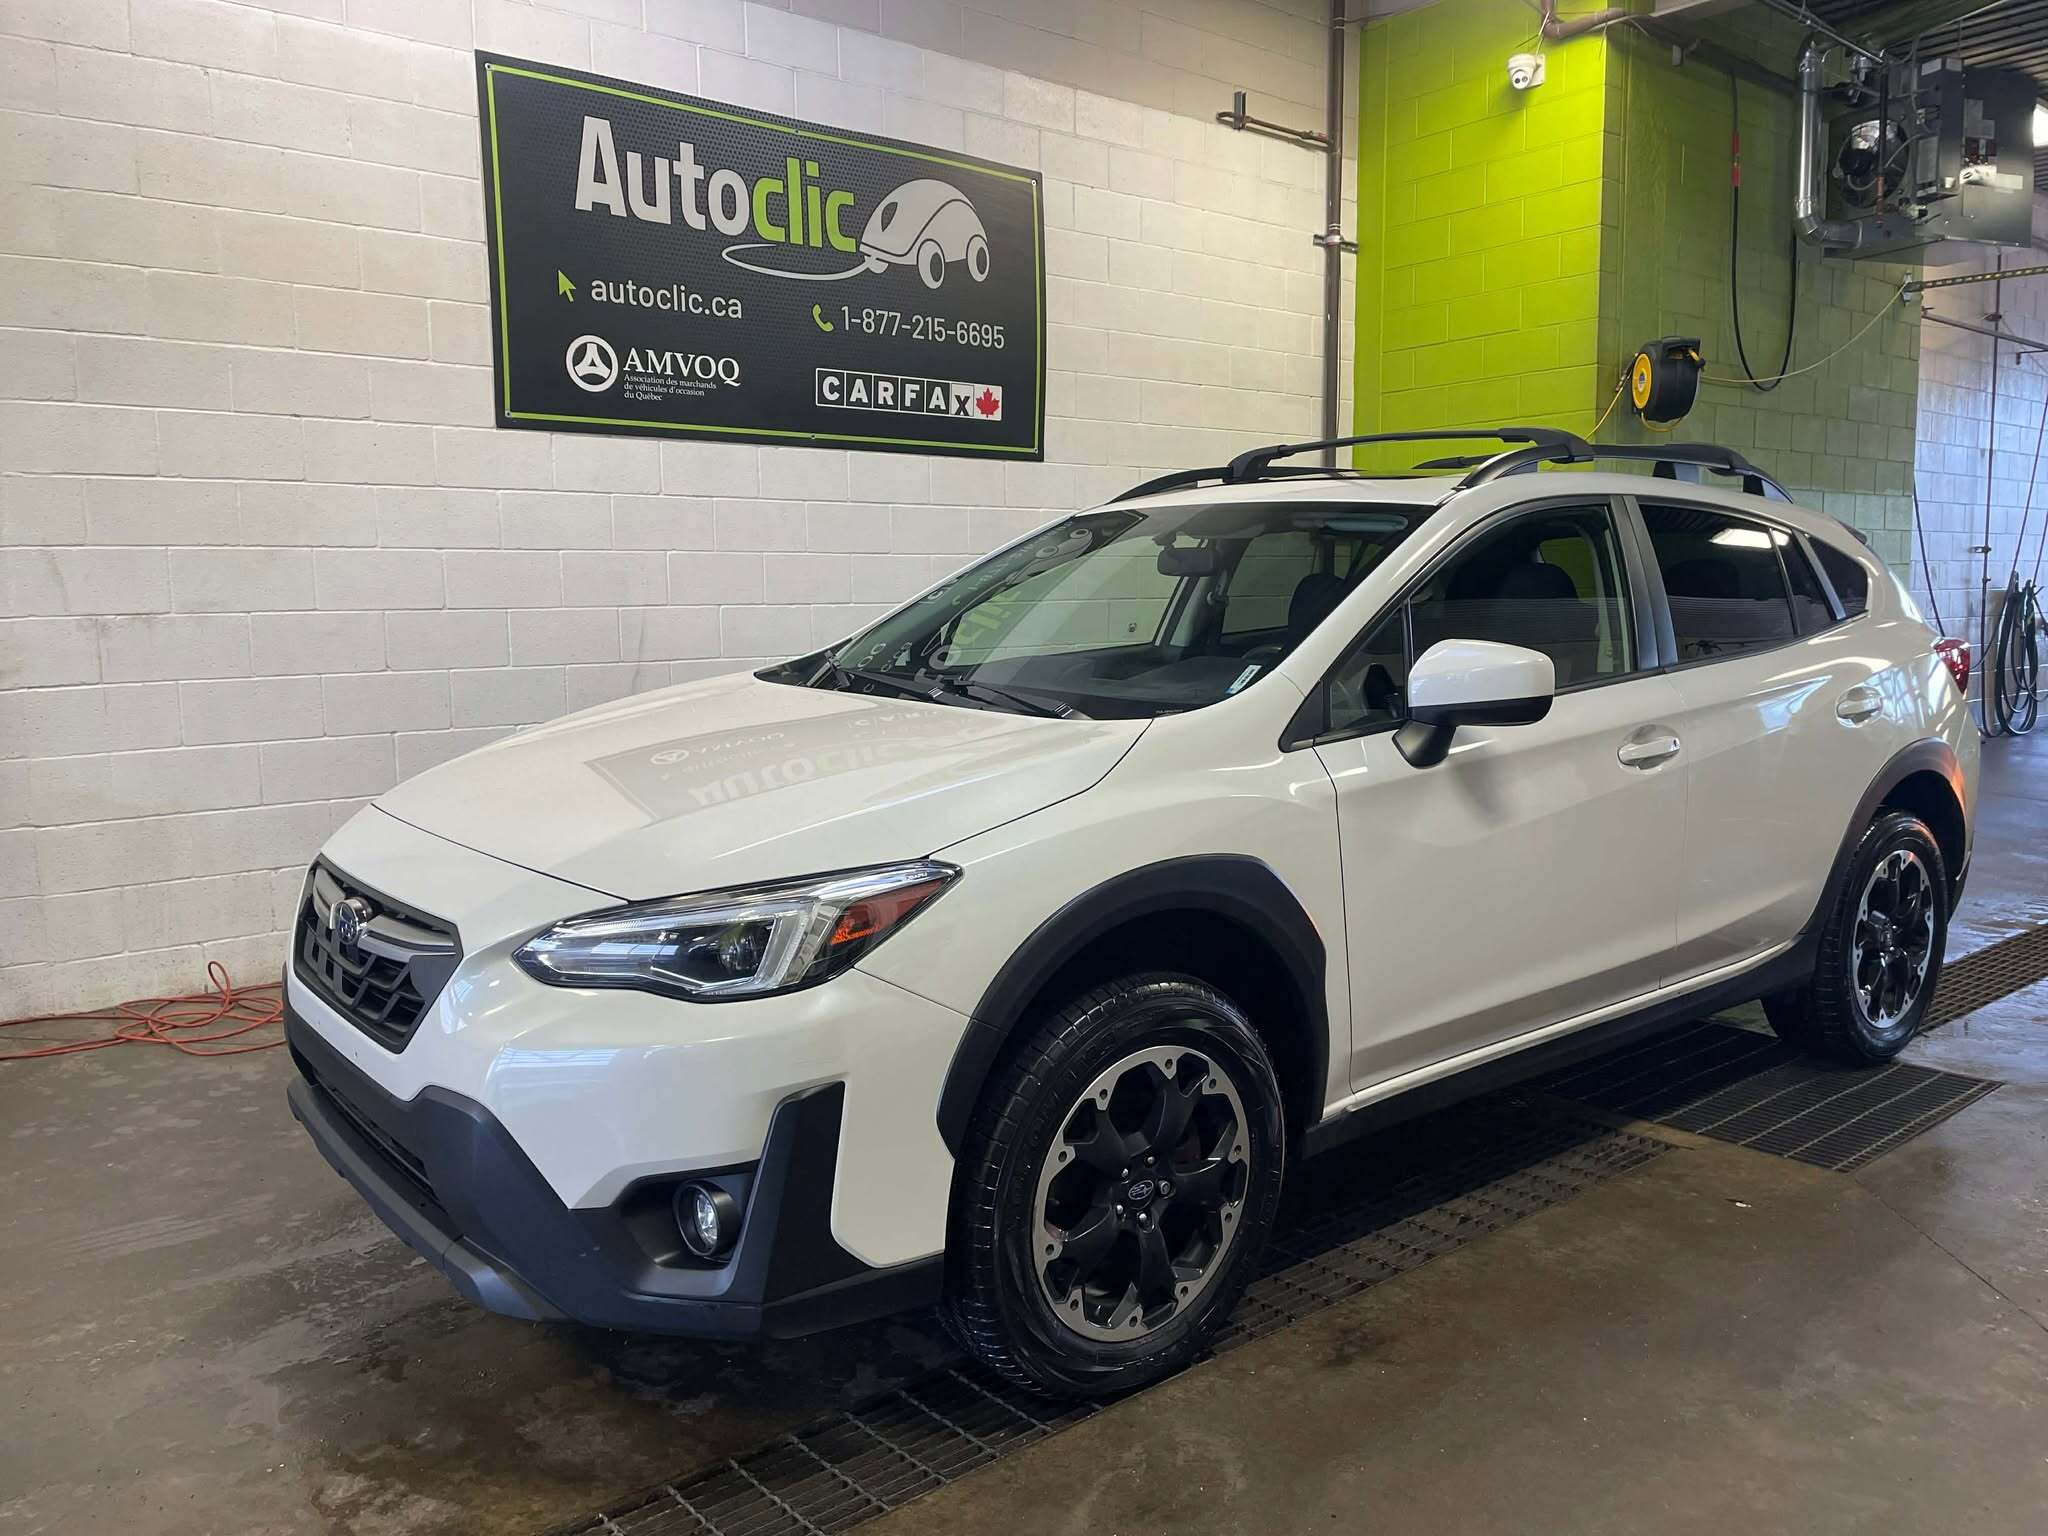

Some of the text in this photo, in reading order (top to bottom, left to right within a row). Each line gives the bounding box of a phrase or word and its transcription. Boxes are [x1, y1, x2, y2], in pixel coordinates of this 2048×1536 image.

[575, 115, 857, 253] Autoclic
[591, 279, 742, 318] autoclic.ca
[841, 305, 1005, 350] 1-877-215-6695
[623, 347, 741, 387] AMVOQ
[624, 374, 717, 389] Association des marchands
[624, 382, 705, 396] de véhicules d'occasion
[635, 391, 662, 400] Québec
[822, 375, 970, 416] CARFAX
